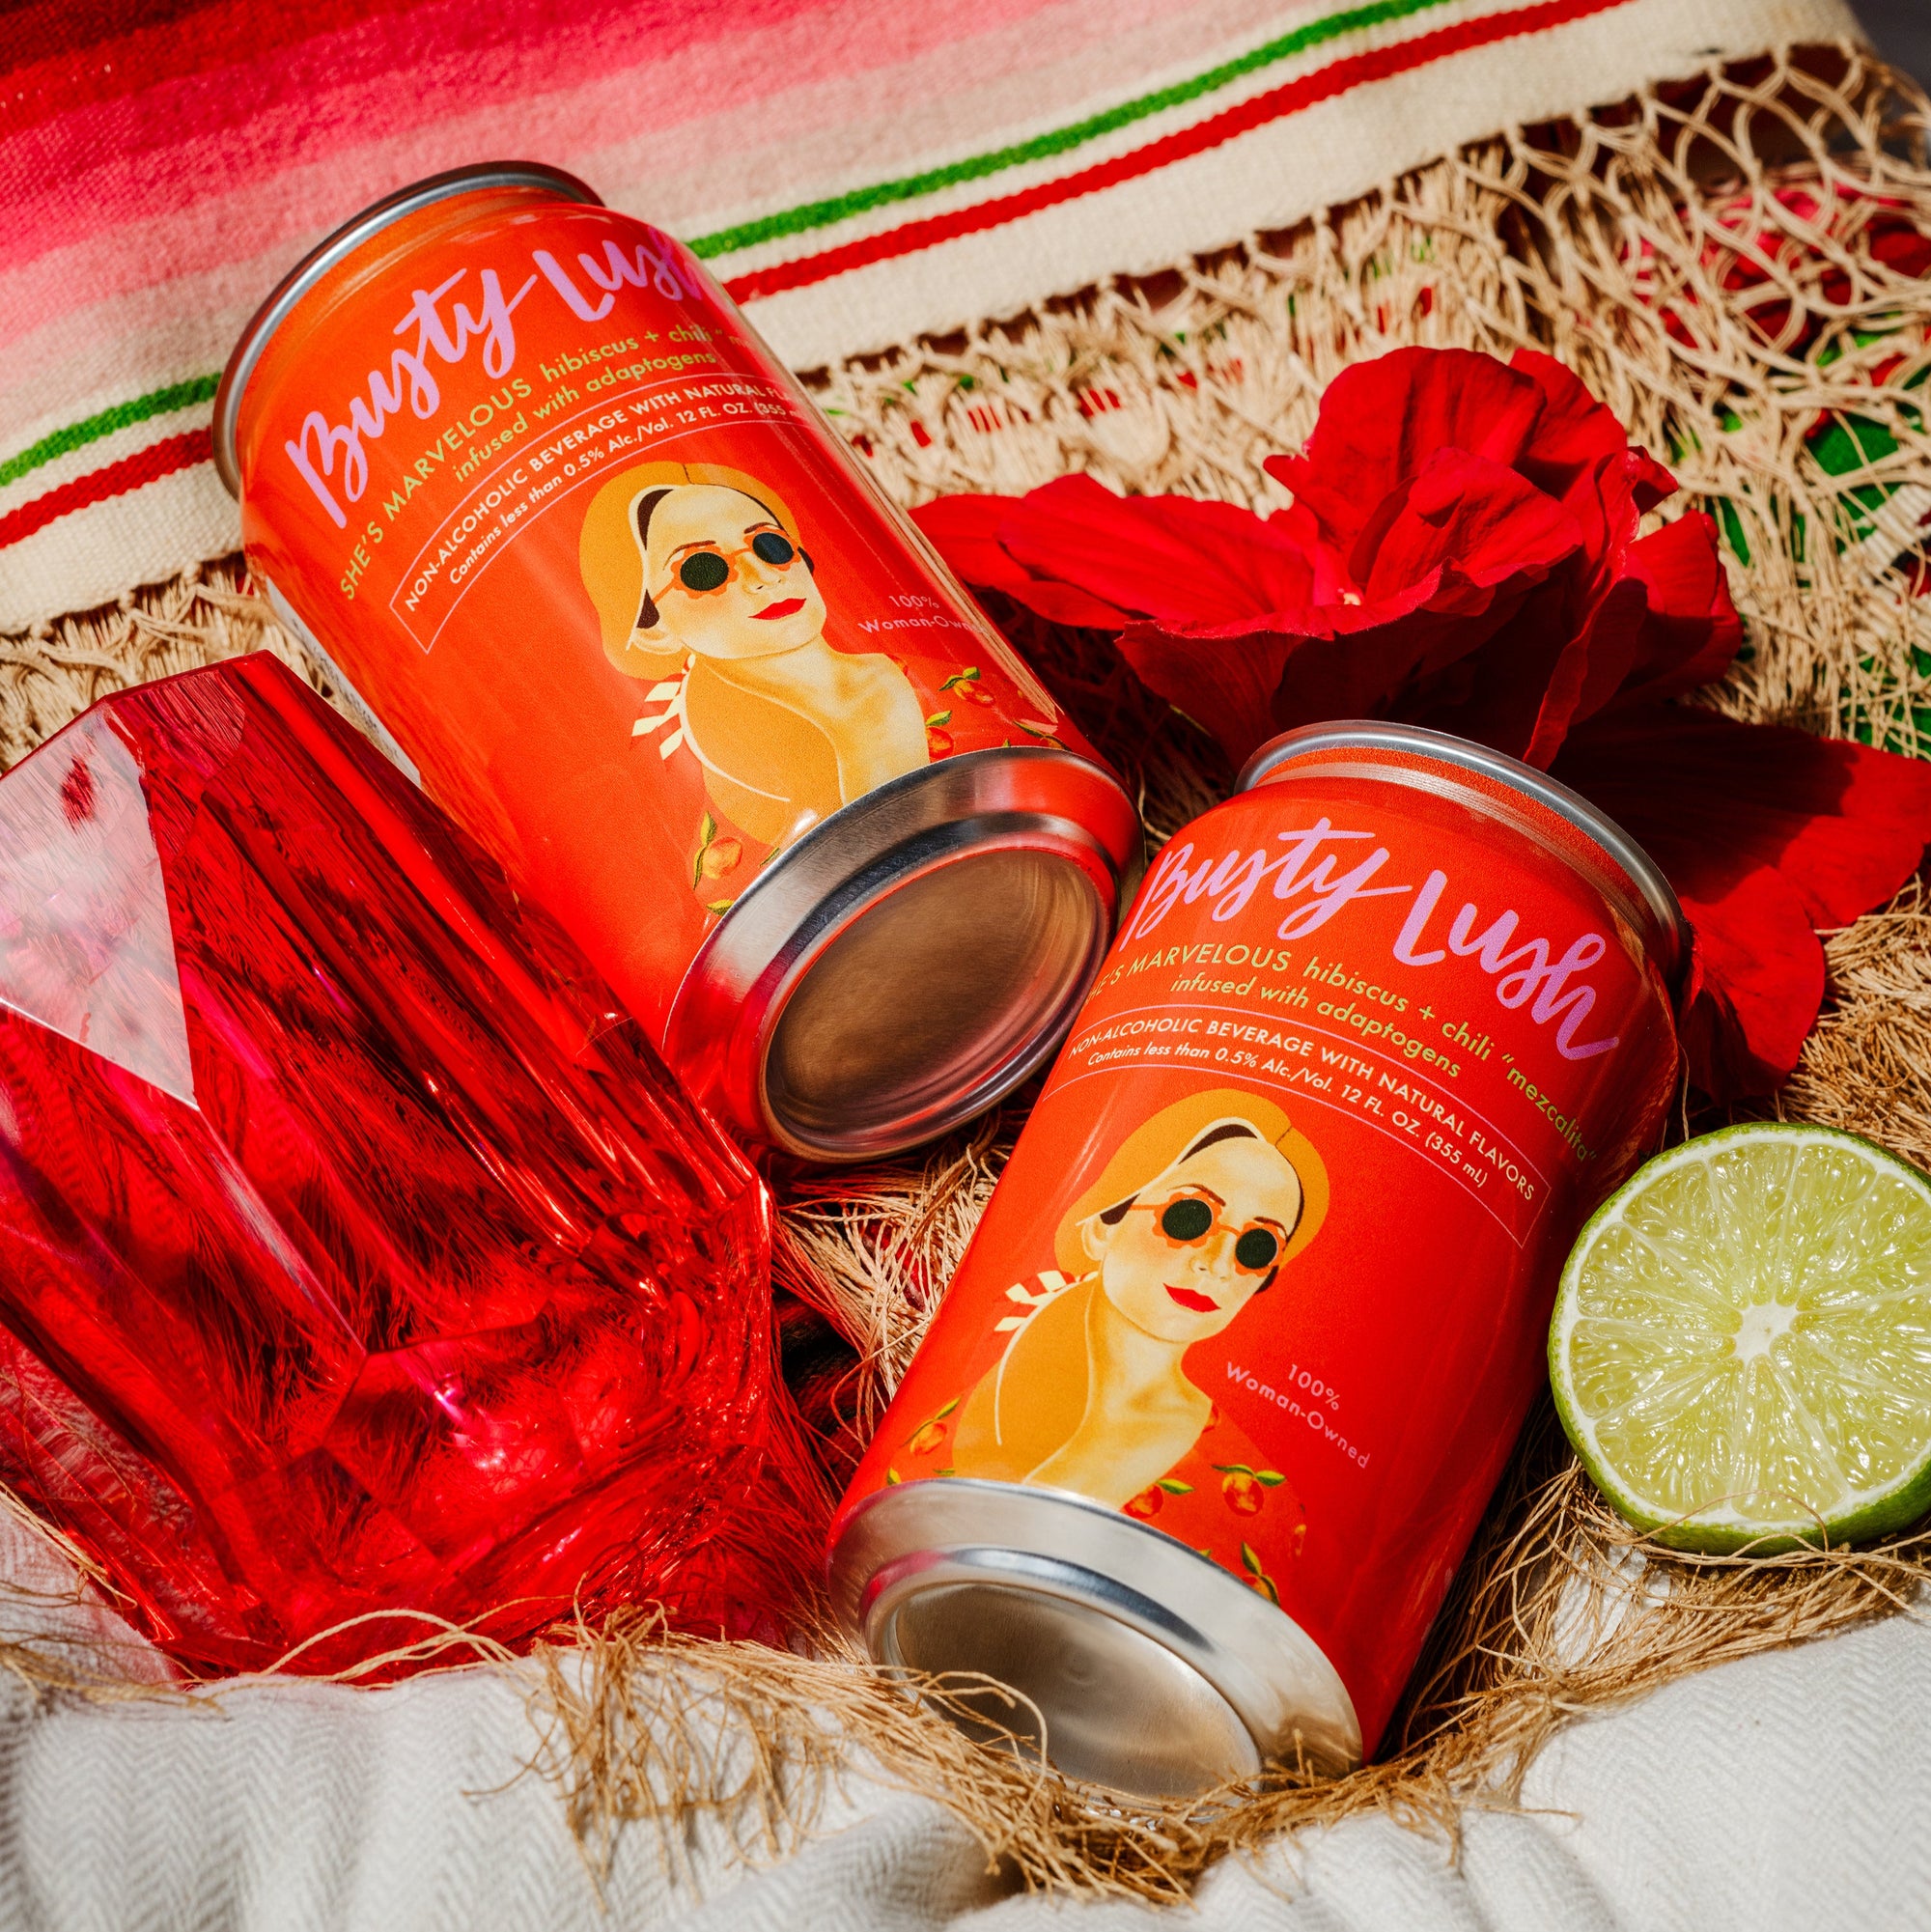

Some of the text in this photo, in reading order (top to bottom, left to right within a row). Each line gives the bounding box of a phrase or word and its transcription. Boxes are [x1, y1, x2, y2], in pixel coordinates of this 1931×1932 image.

[284, 266, 541, 529] Busty
[341, 520, 383, 601] SHE'S
[382, 378, 532, 521] MARVELOUS
[539, 337, 639, 383] hibiscus
[644, 330, 660, 344] +
[668, 323, 713, 343] chili
[452, 352, 716, 483] infused with adaptogens
[405, 467, 528, 612] NON-ALCOHOLIC
[529, 409, 629, 472] BEVERAGE
[629, 390, 682, 415] WITH
[685, 383, 766, 401] NATURAL
[449, 525, 502, 584] Contains
[499, 501, 528, 528] less
[528, 475, 563, 503] than
[563, 446, 605, 477] 0.5%
[608, 416, 674, 454] Alc./Vol.
[676, 409, 697, 425] 12
[698, 405, 721, 419] FL.
[722, 402, 753, 415] OZ.
[888, 594, 940, 609] 100%
[1119, 816, 1619, 1060] Busty Lush
[1126, 943, 1292, 978] MARVELOUS
[1302, 956, 1409, 1012] hibiscus
[1418, 1005, 1436, 1021] +
[1441, 1022, 1496, 1061] chili
[1170, 971, 1461, 1078] infused with adaptogens
[1068, 1018, 1534, 1200] NON-ALCOHOLIC BEVERAGE WITH NATURAL FLAVORS
[1087, 1041, 1488, 1188] Contains less than 0.5% Alc./Vol. 12 FL. OZ. (355 mL)
[1227, 1361, 1370, 1469] Woman-Owned
[1288, 1363, 1340, 1411] 100%
